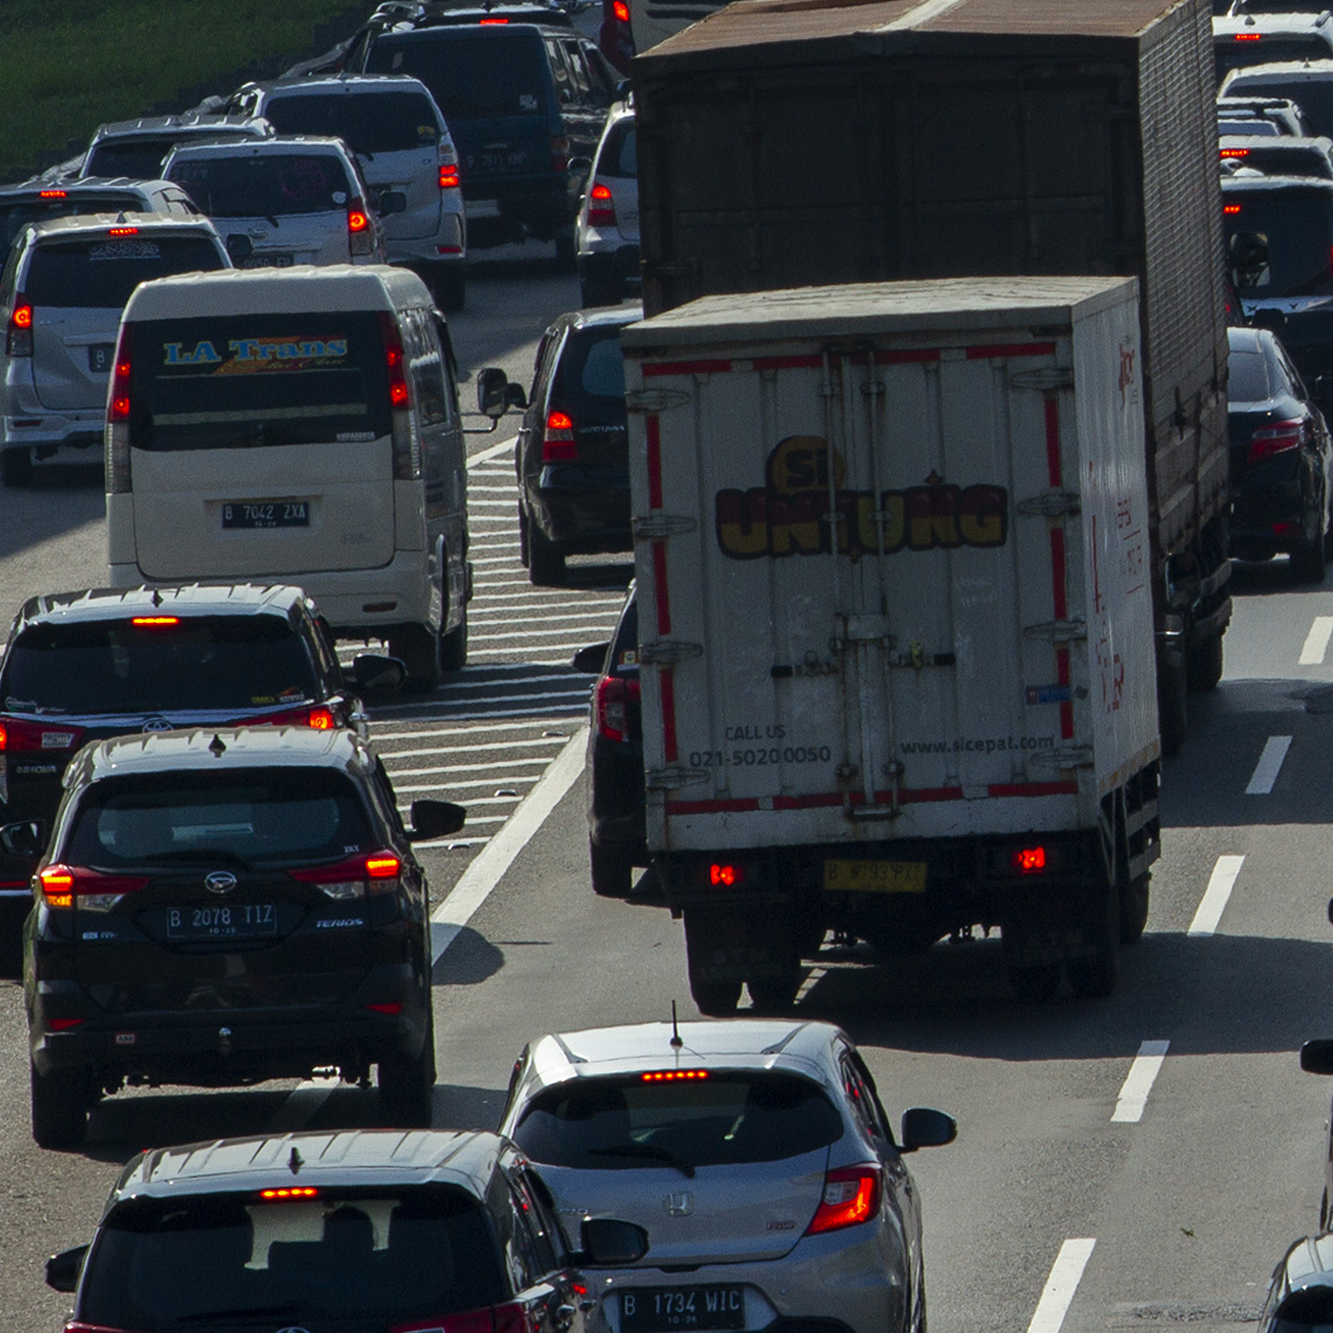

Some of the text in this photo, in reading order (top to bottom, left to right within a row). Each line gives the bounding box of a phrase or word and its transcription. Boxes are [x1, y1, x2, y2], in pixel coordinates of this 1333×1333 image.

[163, 338, 348, 365] LA Trans
[225, 504, 306, 520] B 7042 ZXA
[725, 724, 787, 742] CALL US
[900, 733, 1055, 756] www.sicepat.com
[170, 905, 273, 927] B 2078 TIZ
[315, 918, 364, 928] TERIOS
[624, 1290, 740, 1315] B 1734 WIC
